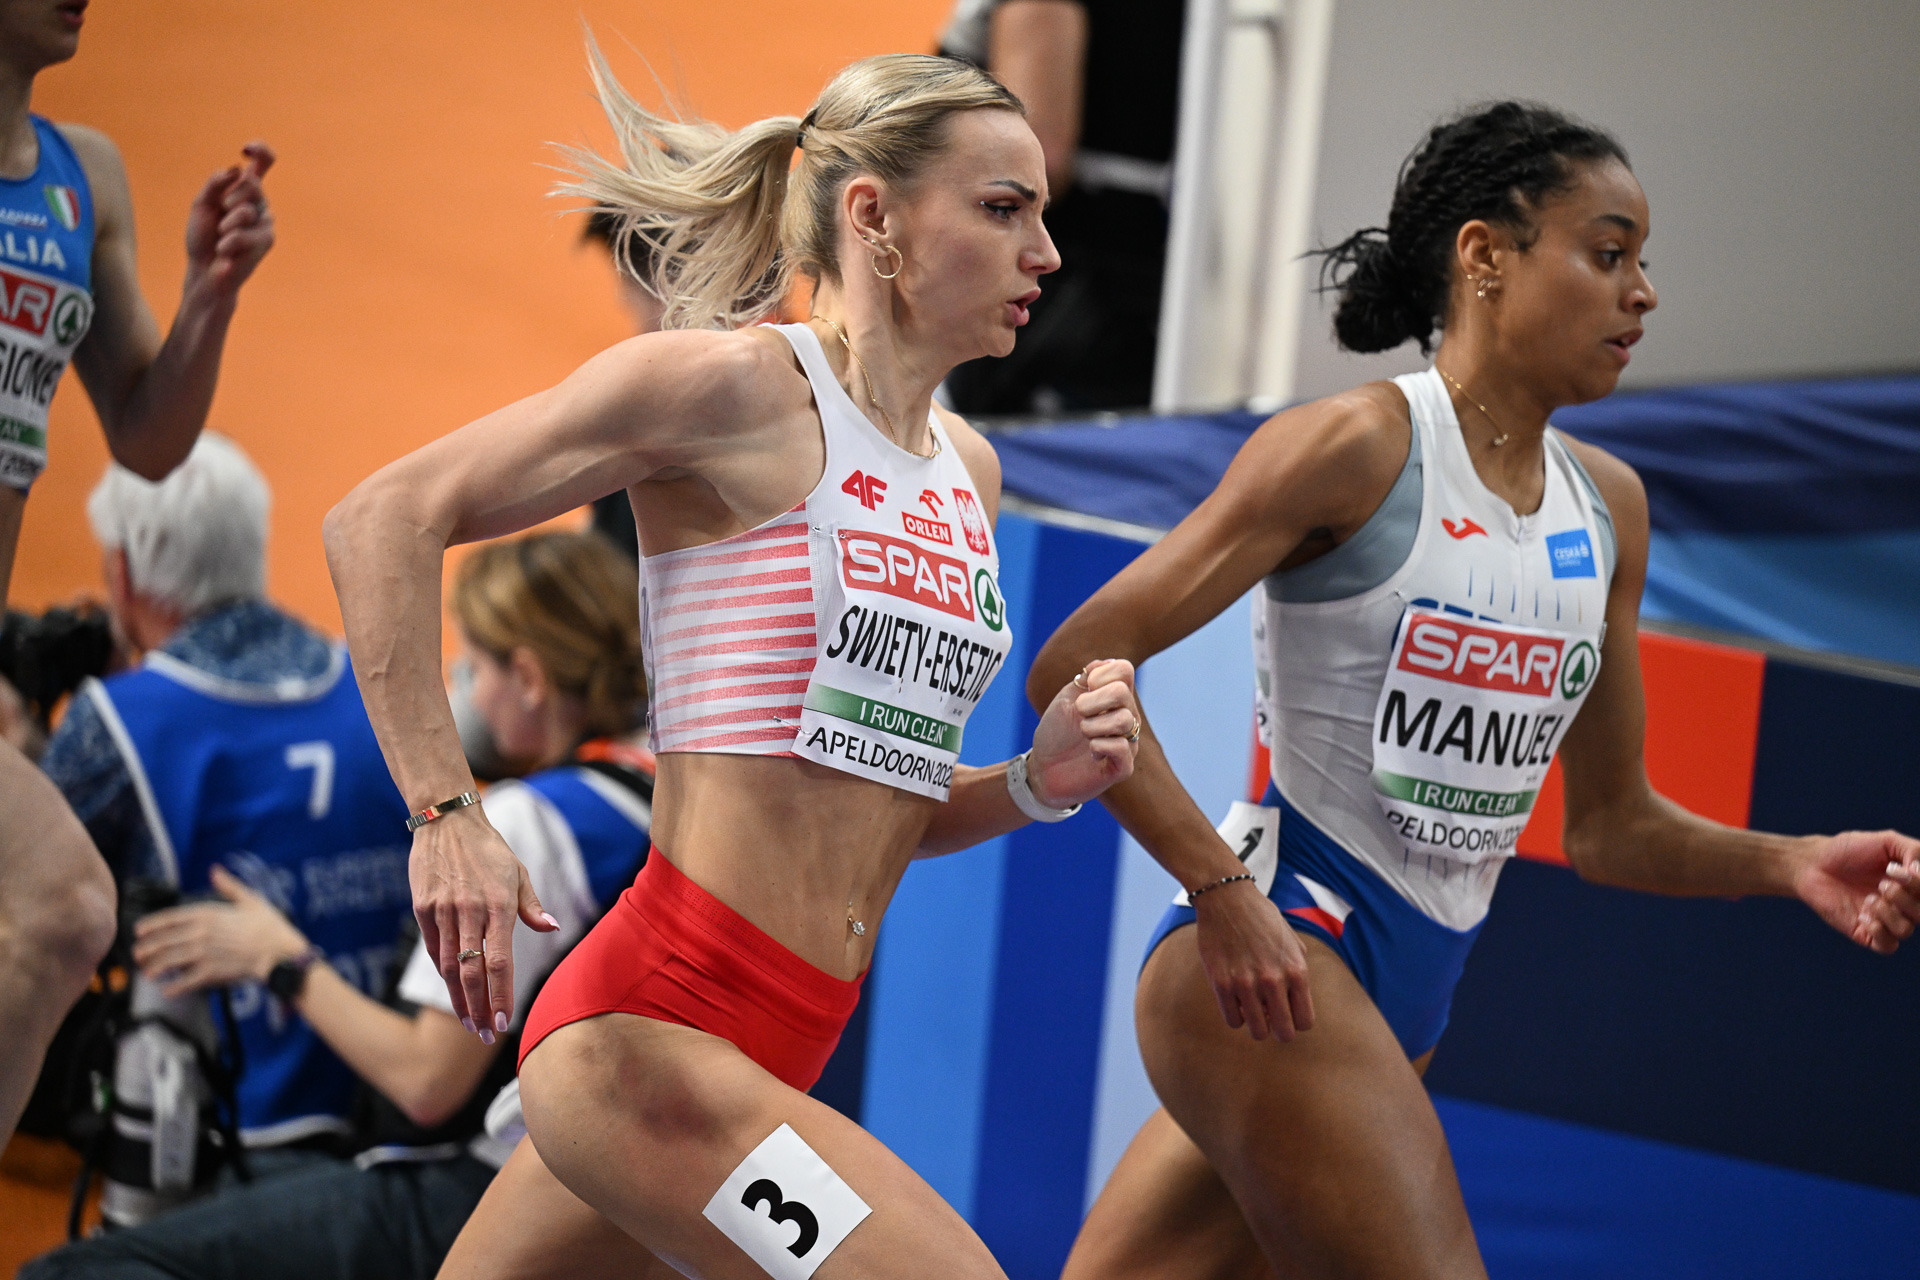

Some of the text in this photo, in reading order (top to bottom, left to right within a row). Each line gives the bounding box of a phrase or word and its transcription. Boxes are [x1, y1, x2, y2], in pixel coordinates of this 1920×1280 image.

[0, 232, 66, 270] LIA
[841, 469, 887, 511] 4F
[904, 518, 950, 543] ORLEN
[847, 539, 971, 611] SPAR
[1406, 622, 1558, 689] SPAR
[860, 701, 867, 721] I
[870, 704, 910, 734] RUN
[1379, 689, 1564, 768] MANUEL
[285, 739, 334, 819] 7
[806, 727, 935, 784] APELDOORN
[1413, 781, 1421, 802] I
[1424, 784, 1474, 812] RUN
[741, 1178, 819, 1259] 3
